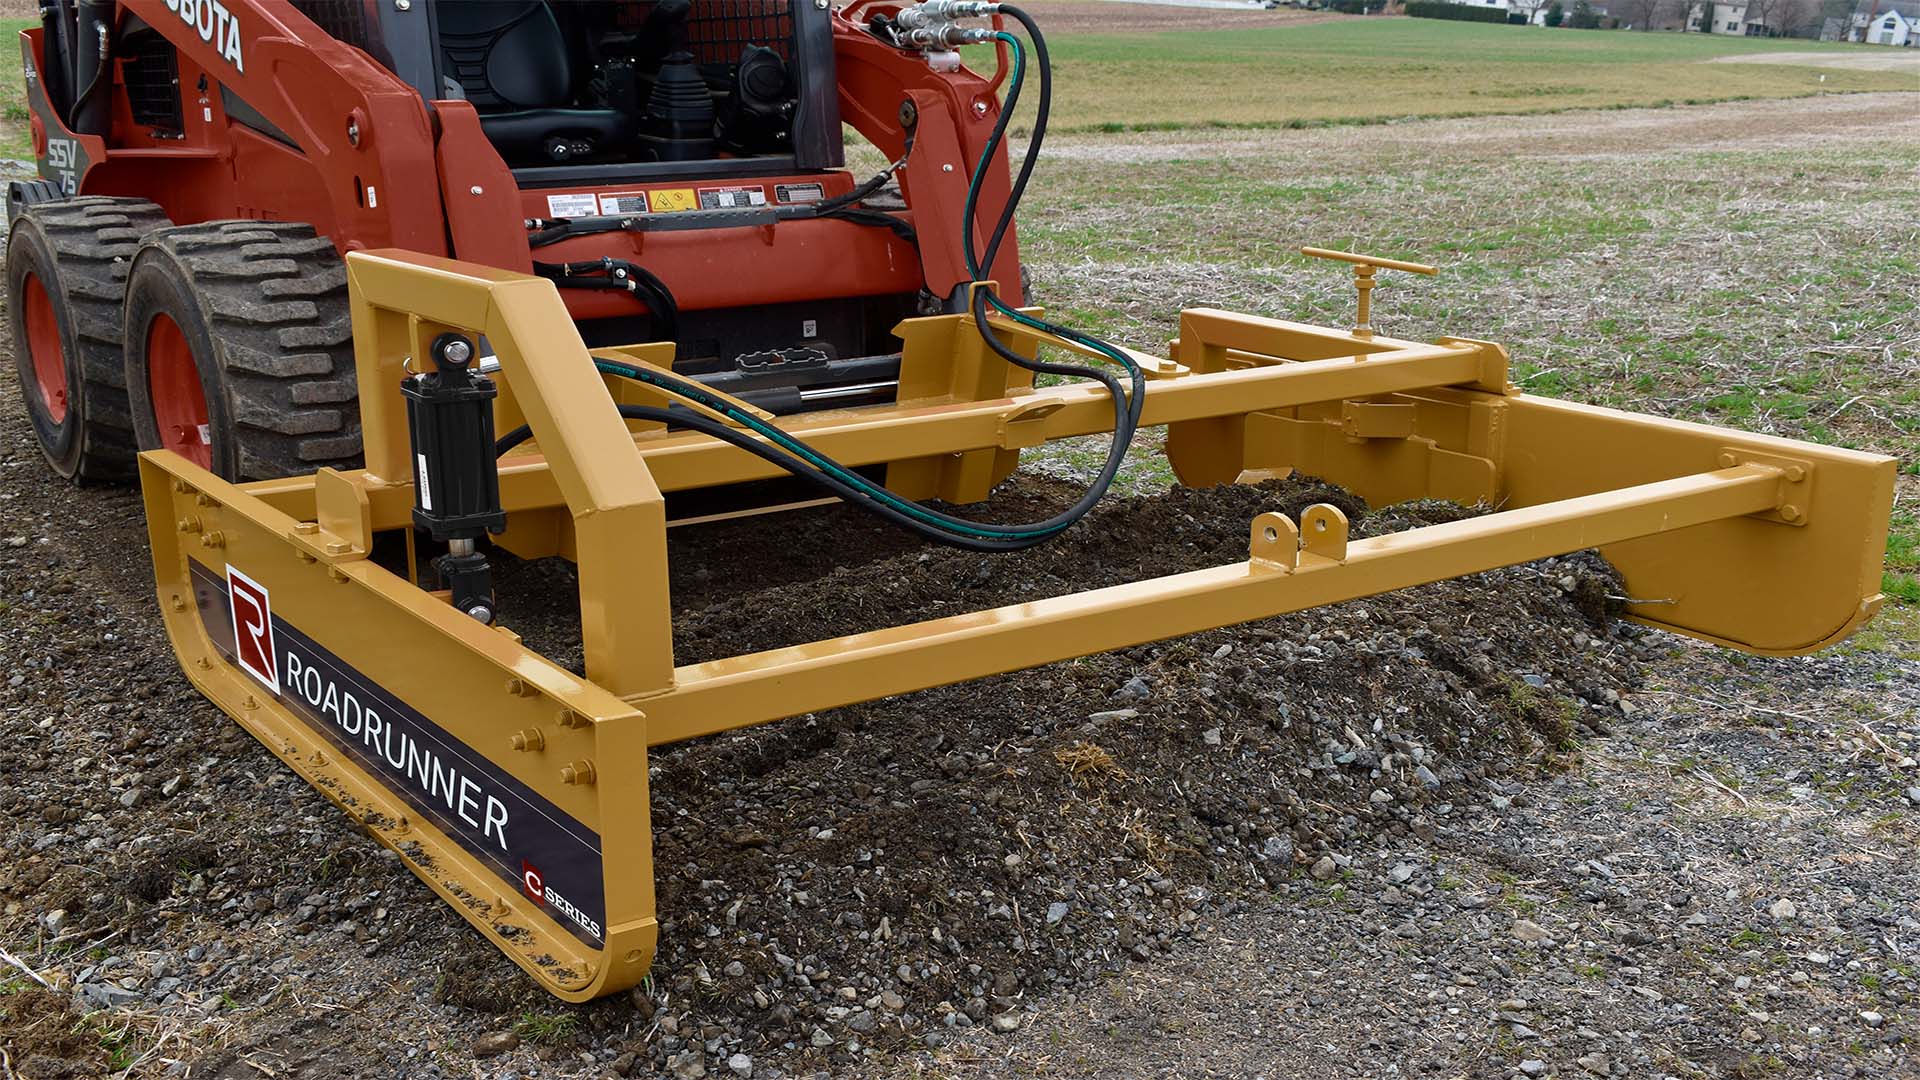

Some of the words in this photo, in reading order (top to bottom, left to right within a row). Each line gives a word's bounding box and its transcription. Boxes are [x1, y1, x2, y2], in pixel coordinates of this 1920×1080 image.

[48, 139, 77, 168] SSV
[59, 169, 77, 195] 75
[286, 651, 509, 851] ROADRUNNER
[525, 870, 542, 896] C
[545, 886, 601, 938] SERIES
